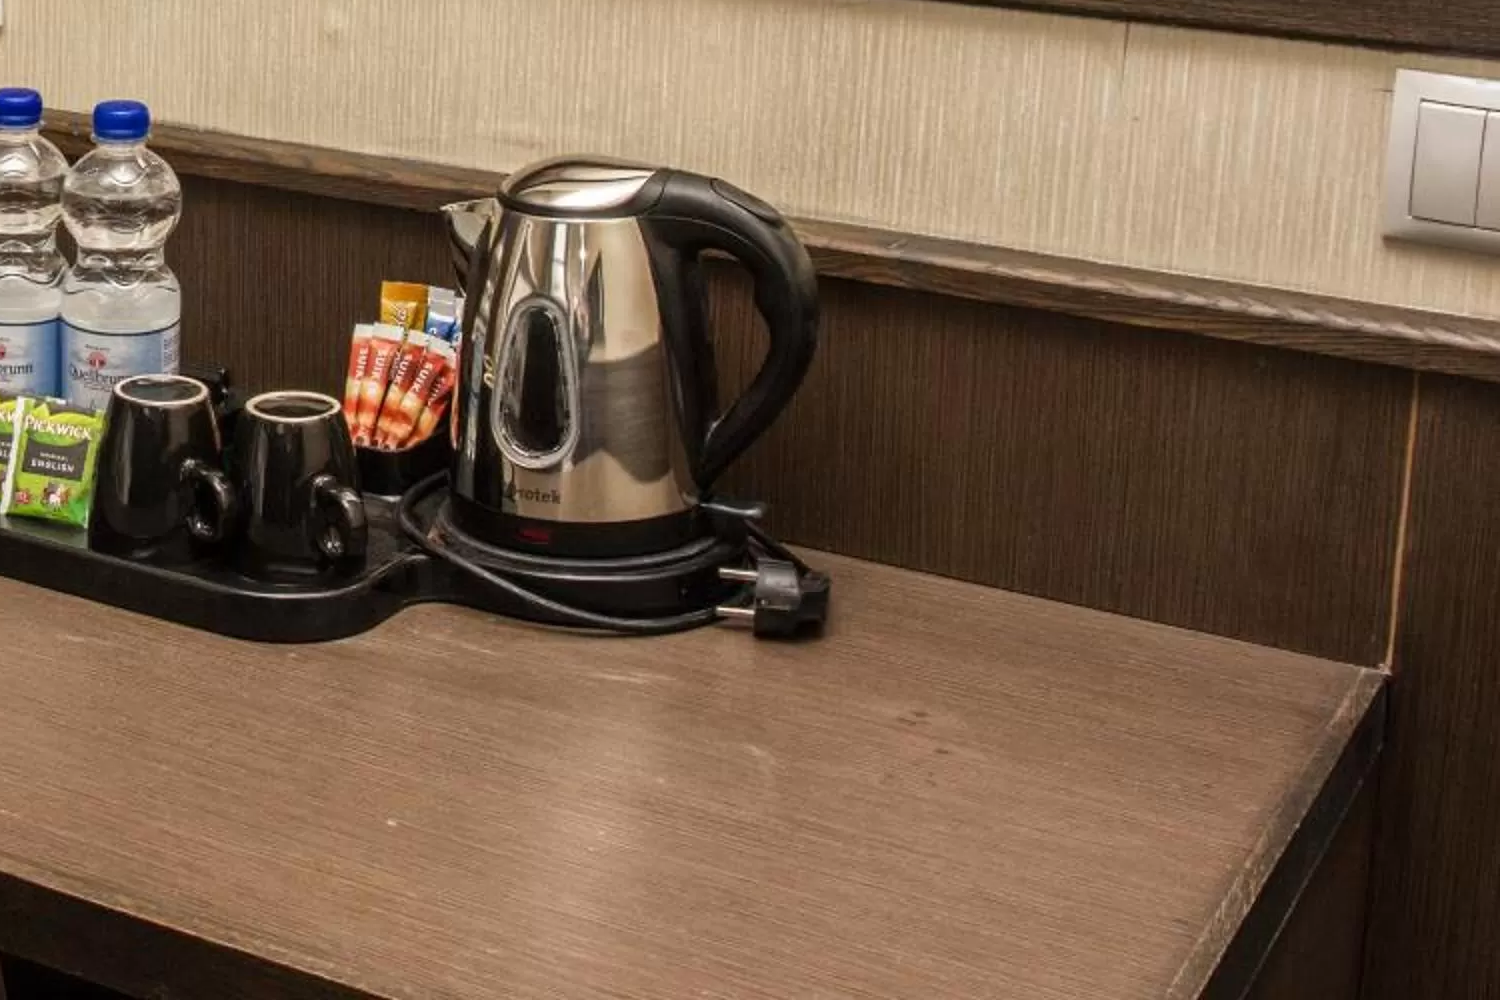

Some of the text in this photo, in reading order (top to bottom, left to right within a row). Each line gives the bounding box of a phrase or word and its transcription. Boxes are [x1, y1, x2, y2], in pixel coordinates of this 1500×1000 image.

[69, 362, 132, 384] Quellbrun
[25, 414, 92, 440] PICKWICK
[31, 459, 75, 473] ENGLISH
